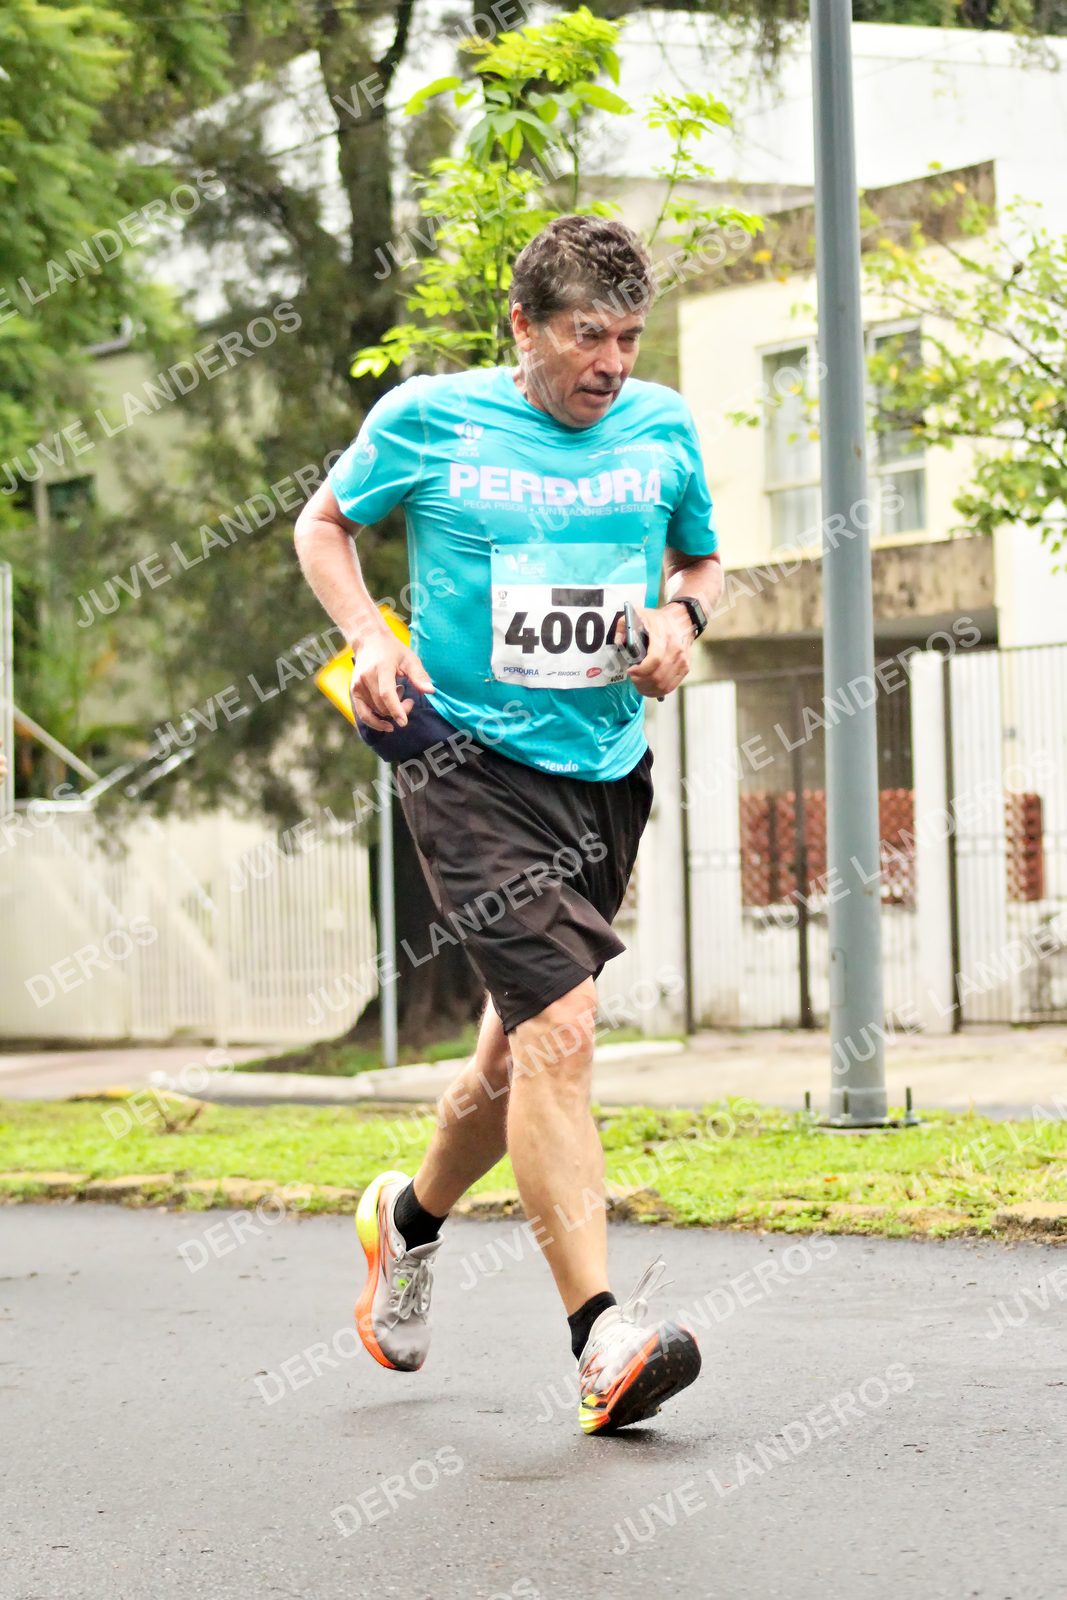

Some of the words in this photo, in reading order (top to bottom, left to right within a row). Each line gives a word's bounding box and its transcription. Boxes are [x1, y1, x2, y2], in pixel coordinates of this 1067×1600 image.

[449, 462, 661, 507] PERDURA
[464, 499, 492, 511] PEGA
[503, 666, 540, 677] PERDURA
[557, 670, 581, 678] BROOKS
